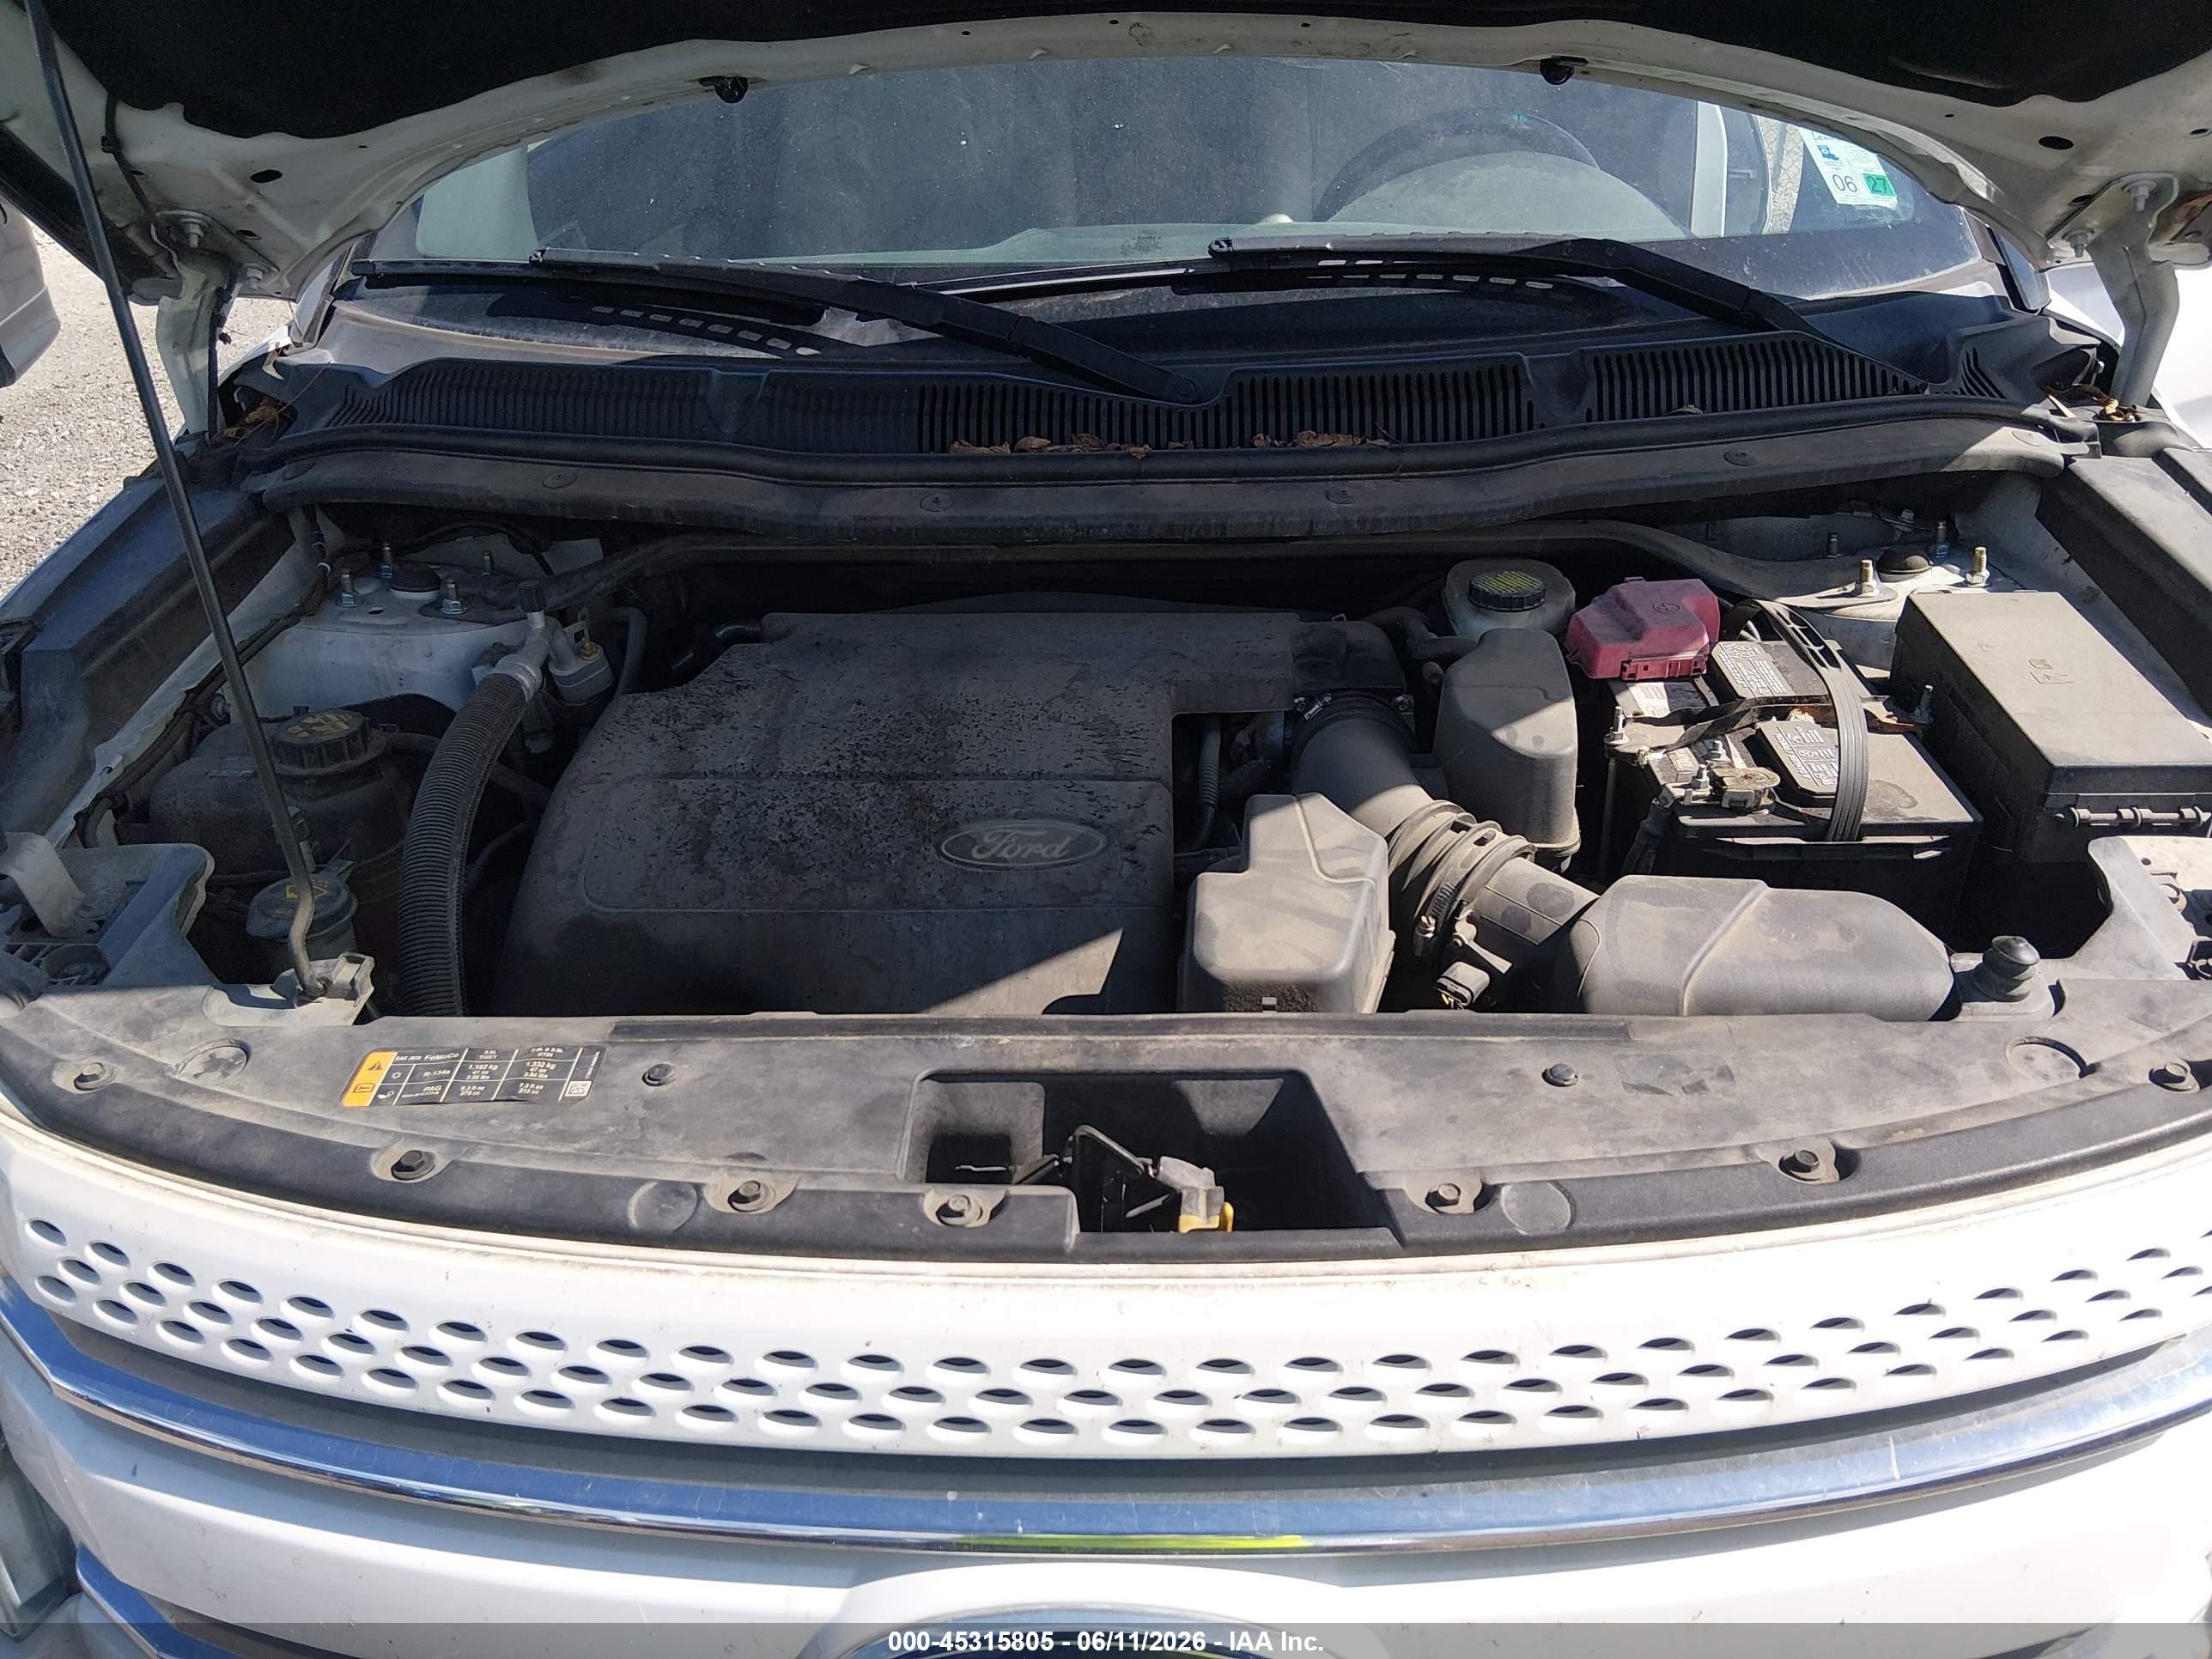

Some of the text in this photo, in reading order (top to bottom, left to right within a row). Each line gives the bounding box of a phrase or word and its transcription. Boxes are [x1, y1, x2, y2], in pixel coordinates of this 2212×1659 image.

[1832, 174, 1857, 192] 06
[1866, 176, 1888, 193] 27
[971, 829, 1073, 860] Ford
[422, 1069, 451, 1078] R-134a
[546, 1061, 556, 1070] kg
